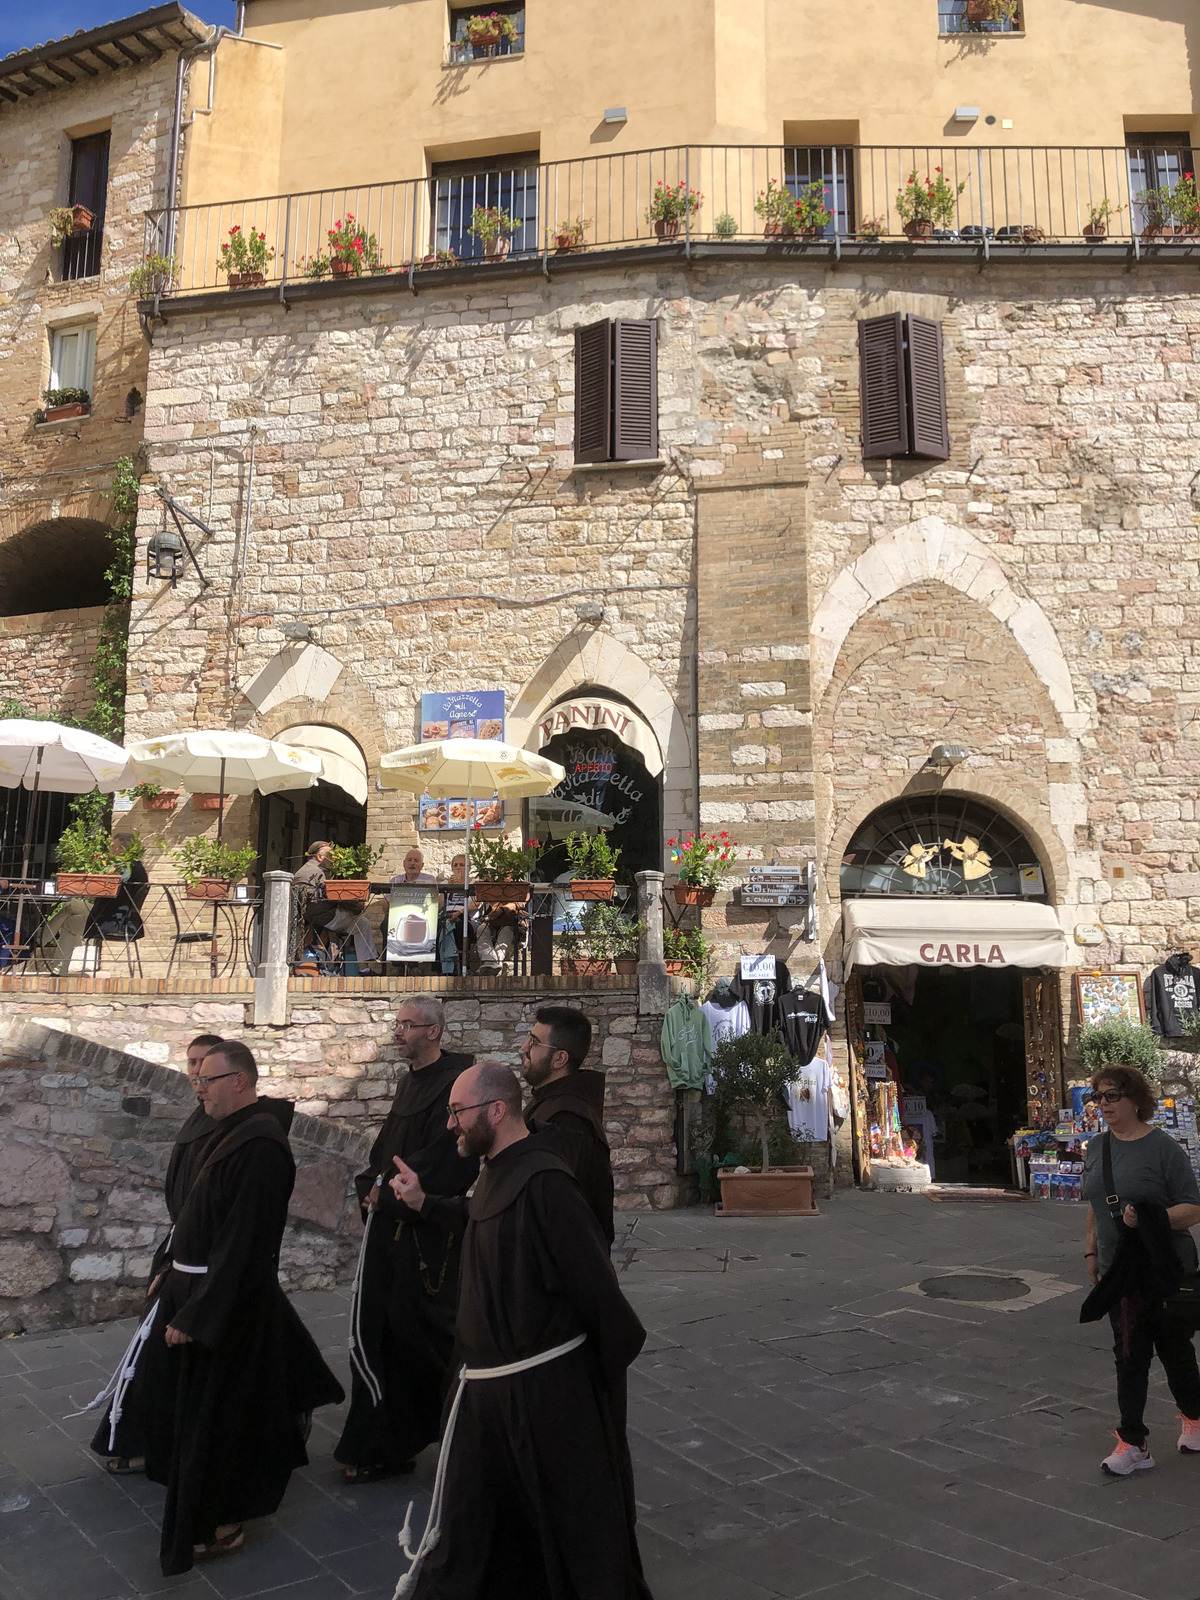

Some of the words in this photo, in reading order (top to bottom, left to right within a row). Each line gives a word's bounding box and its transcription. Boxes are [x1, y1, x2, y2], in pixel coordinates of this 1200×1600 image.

[449, 694, 483, 708] Piazzetta
[459, 702, 467, 710] di
[449, 710, 478, 719] Agnese
[539, 706, 632, 741] PANINI
[569, 746, 618, 764] BAR
[574, 763, 613, 773] APERTO
[562, 770, 643, 802] Piazzetta
[585, 788, 604, 806] di
[919, 943, 1006, 963] CARLA
[913, 1101, 924, 1112] 10
